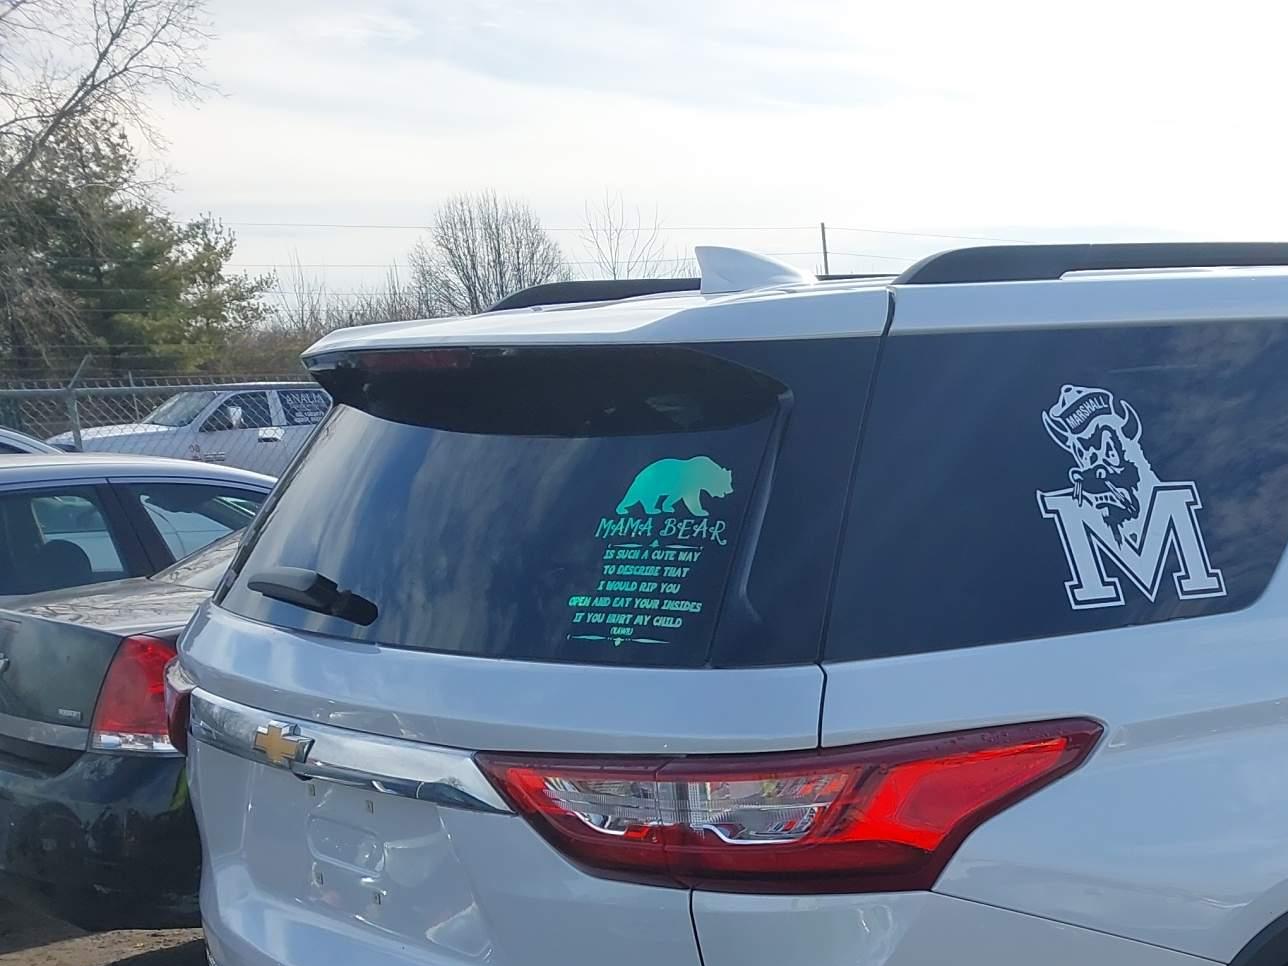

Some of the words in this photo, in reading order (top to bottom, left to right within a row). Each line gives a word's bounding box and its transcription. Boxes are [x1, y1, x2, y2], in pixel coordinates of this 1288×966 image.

[1065, 396, 1108, 430] MARSHALL
[594, 517, 653, 539] MAMA
[659, 518, 727, 545] BEAR
[1036, 481, 1227, 610] M
[603, 550, 615, 560] IS
[616, 550, 640, 560] SUCH
[641, 550, 648, 560] A
[651, 550, 676, 560] CUTE
[678, 552, 701, 562] WAY
[603, 565, 616, 575] TO
[616, 565, 661, 576] DESCRIBE
[663, 567, 690, 578] THAT
[597, 581, 606, 590] I
[606, 581, 637, 592] WOULD
[639, 582, 658, 592] RIP
[660, 583, 681, 593] YOU
[568, 596, 591, 607] OPEN
[592, 596, 611, 607] AND
[612, 597, 632, 607] EAT
[634, 598, 659, 609] YOUR
[661, 599, 702, 612] INSIDES
[586, 613, 605, 623] YOU
[606, 613, 632, 625] HURT
[633, 615, 651, 626] MY
[653, 617, 683, 628] CHILD
